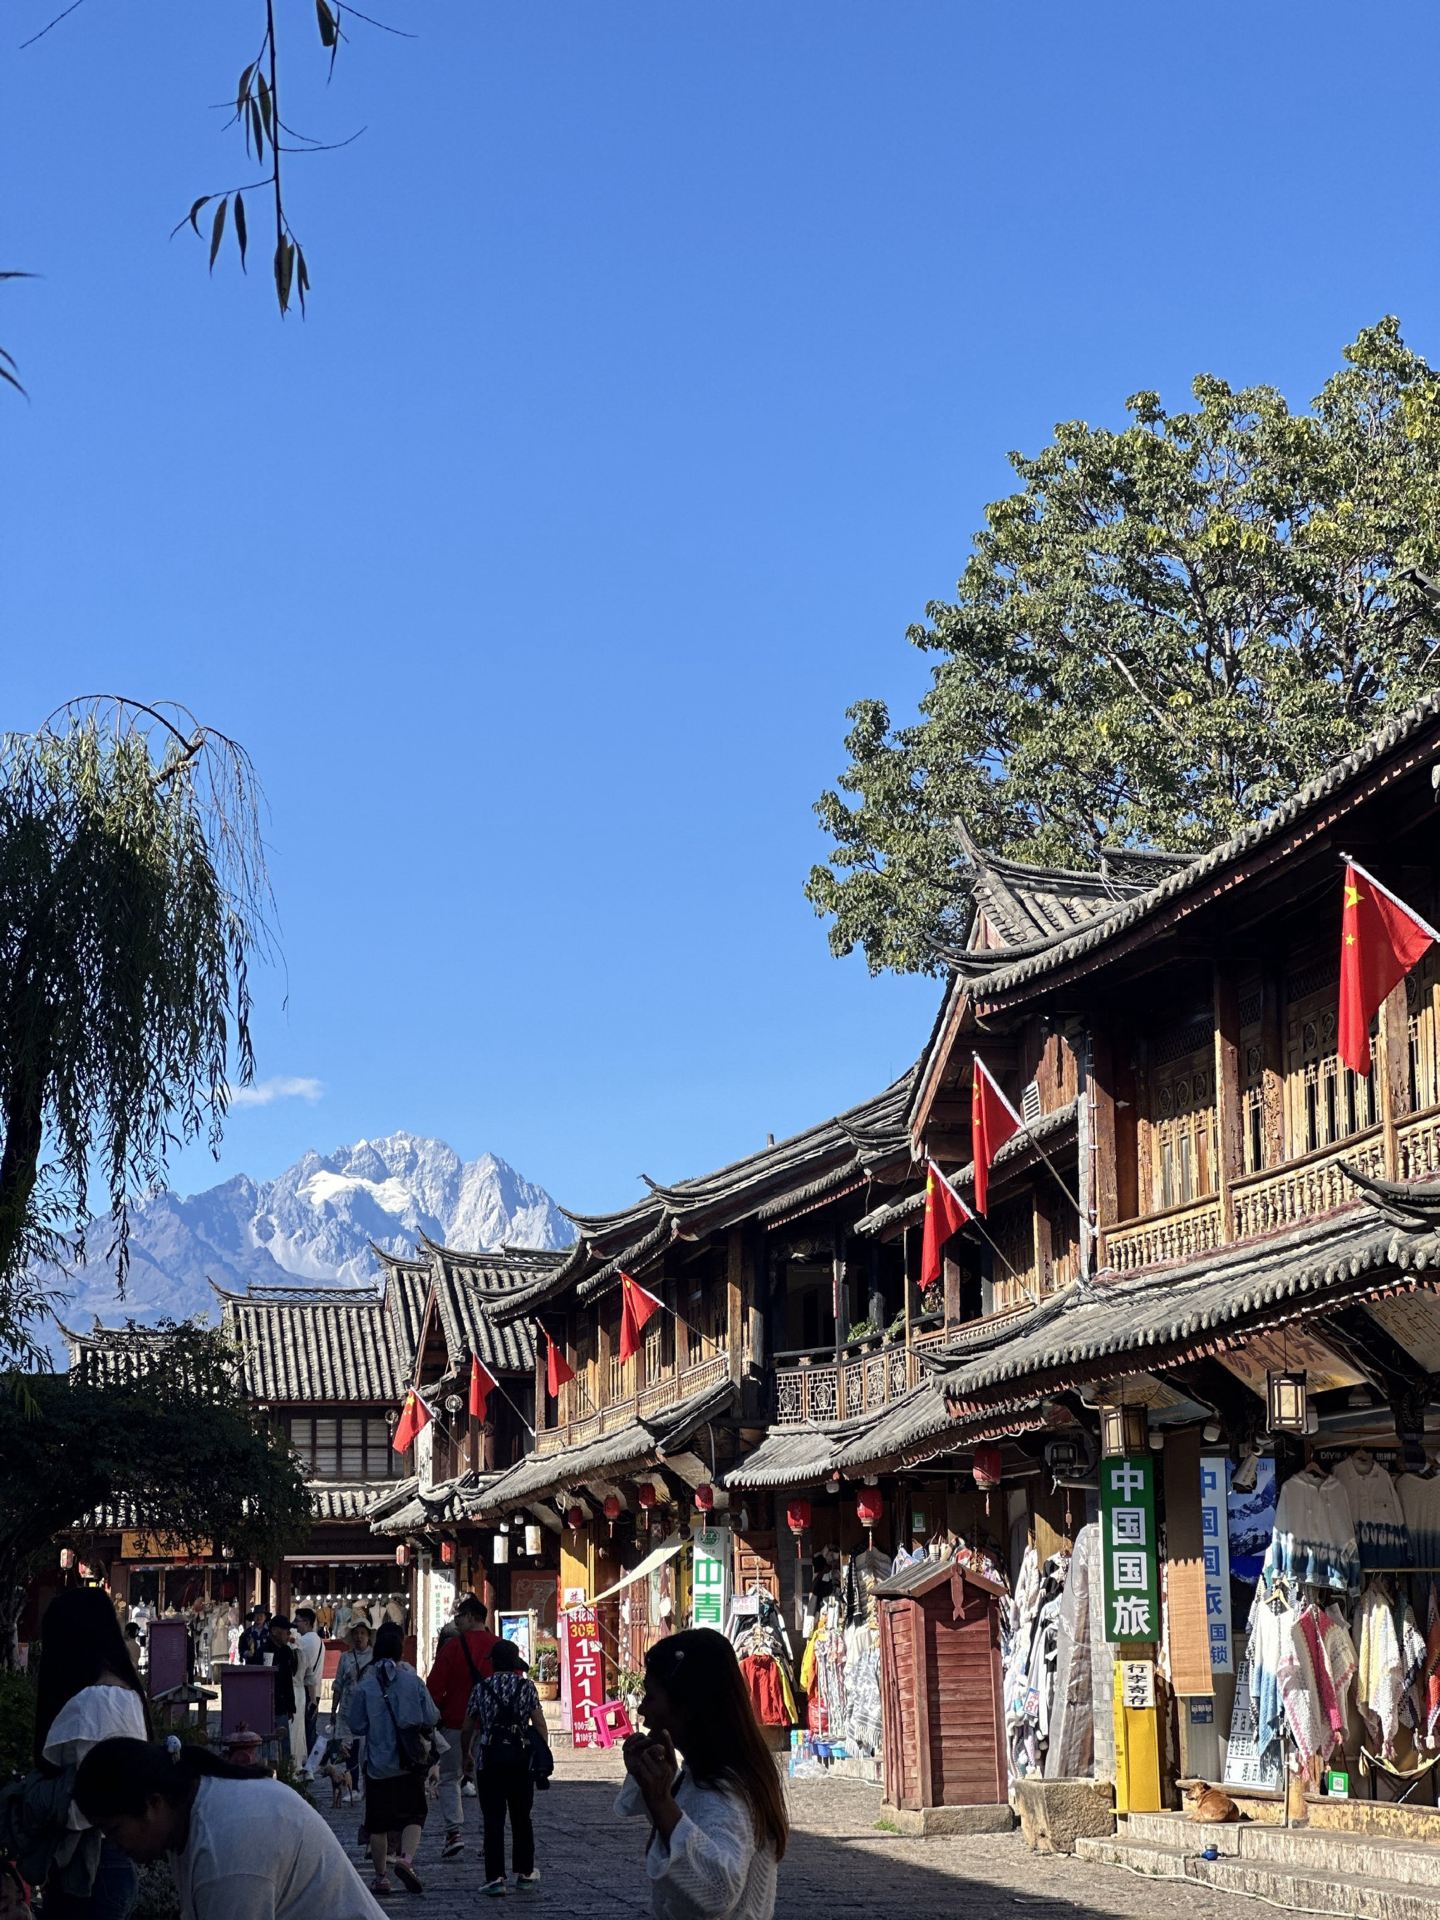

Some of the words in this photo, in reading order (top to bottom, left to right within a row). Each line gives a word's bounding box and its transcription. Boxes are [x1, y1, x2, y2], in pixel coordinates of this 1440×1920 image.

[1111, 1462, 1151, 1636] 中国国旅
[695, 1558, 721, 1622] 中青
[570, 1623, 596, 1637] 30克
[573, 1639, 598, 1718] 1元1个
[1127, 1664, 1148, 1705] 行李寄存
